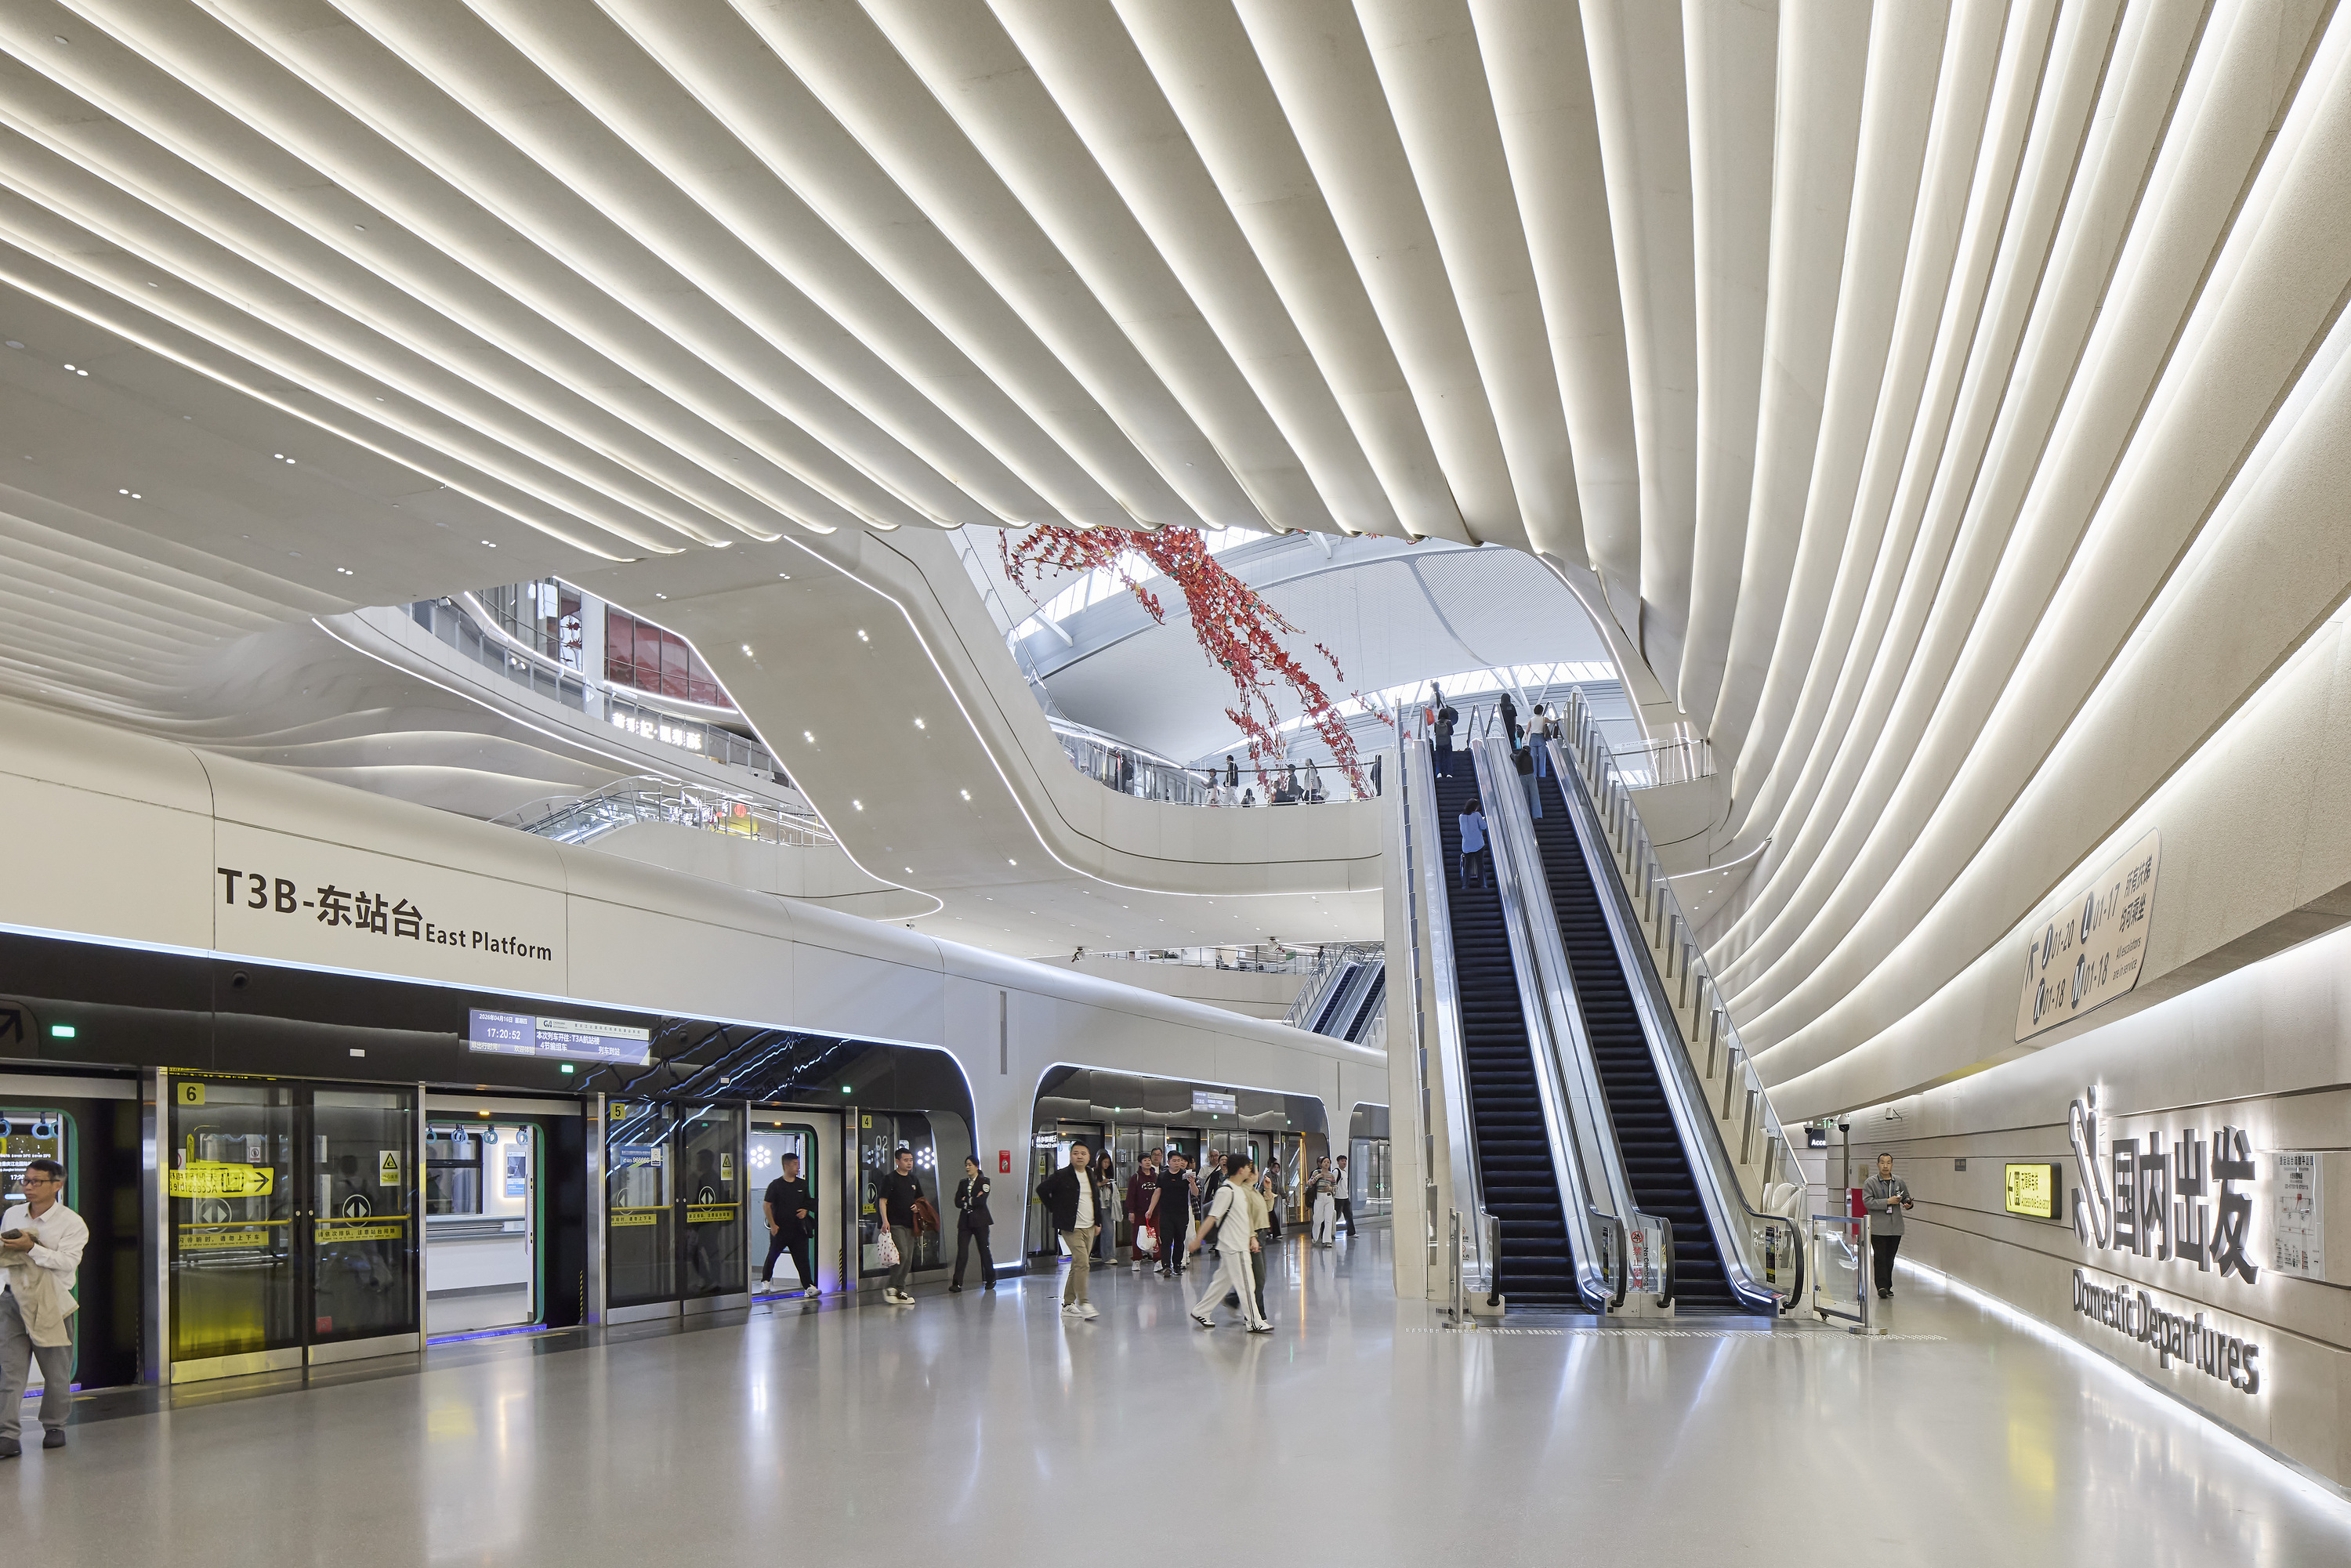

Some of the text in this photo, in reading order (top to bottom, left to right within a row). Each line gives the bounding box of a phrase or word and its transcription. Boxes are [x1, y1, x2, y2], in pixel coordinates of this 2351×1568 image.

[2124, 853, 2153, 899] 所有扶梯
[2092, 882, 2121, 932] 01-17
[426, 922, 466, 948] East
[473, 930, 552, 961] Platform
[2051, 918, 2074, 960] 01-20
[2122, 936, 2142, 956] escalators
[2083, 951, 2110, 996] 01-18
[2122, 958, 2138, 975] service
[2042, 978, 2066, 1016] 01-18
[479, 1013, 513, 1023] 2026年04月16日
[487, 1027, 521, 1041] 17:20:52
[598, 1045, 621, 1057] 列车到站
[186, 1086, 197, 1102] 6
[615, 1106, 621, 1117] 5
[865, 1117, 870, 1127] 4
[2113, 1124, 2260, 1286] 国内出发
[1643, 1247, 1649, 1257] No
[2073, 1267, 2260, 1396] Domestic Departures
